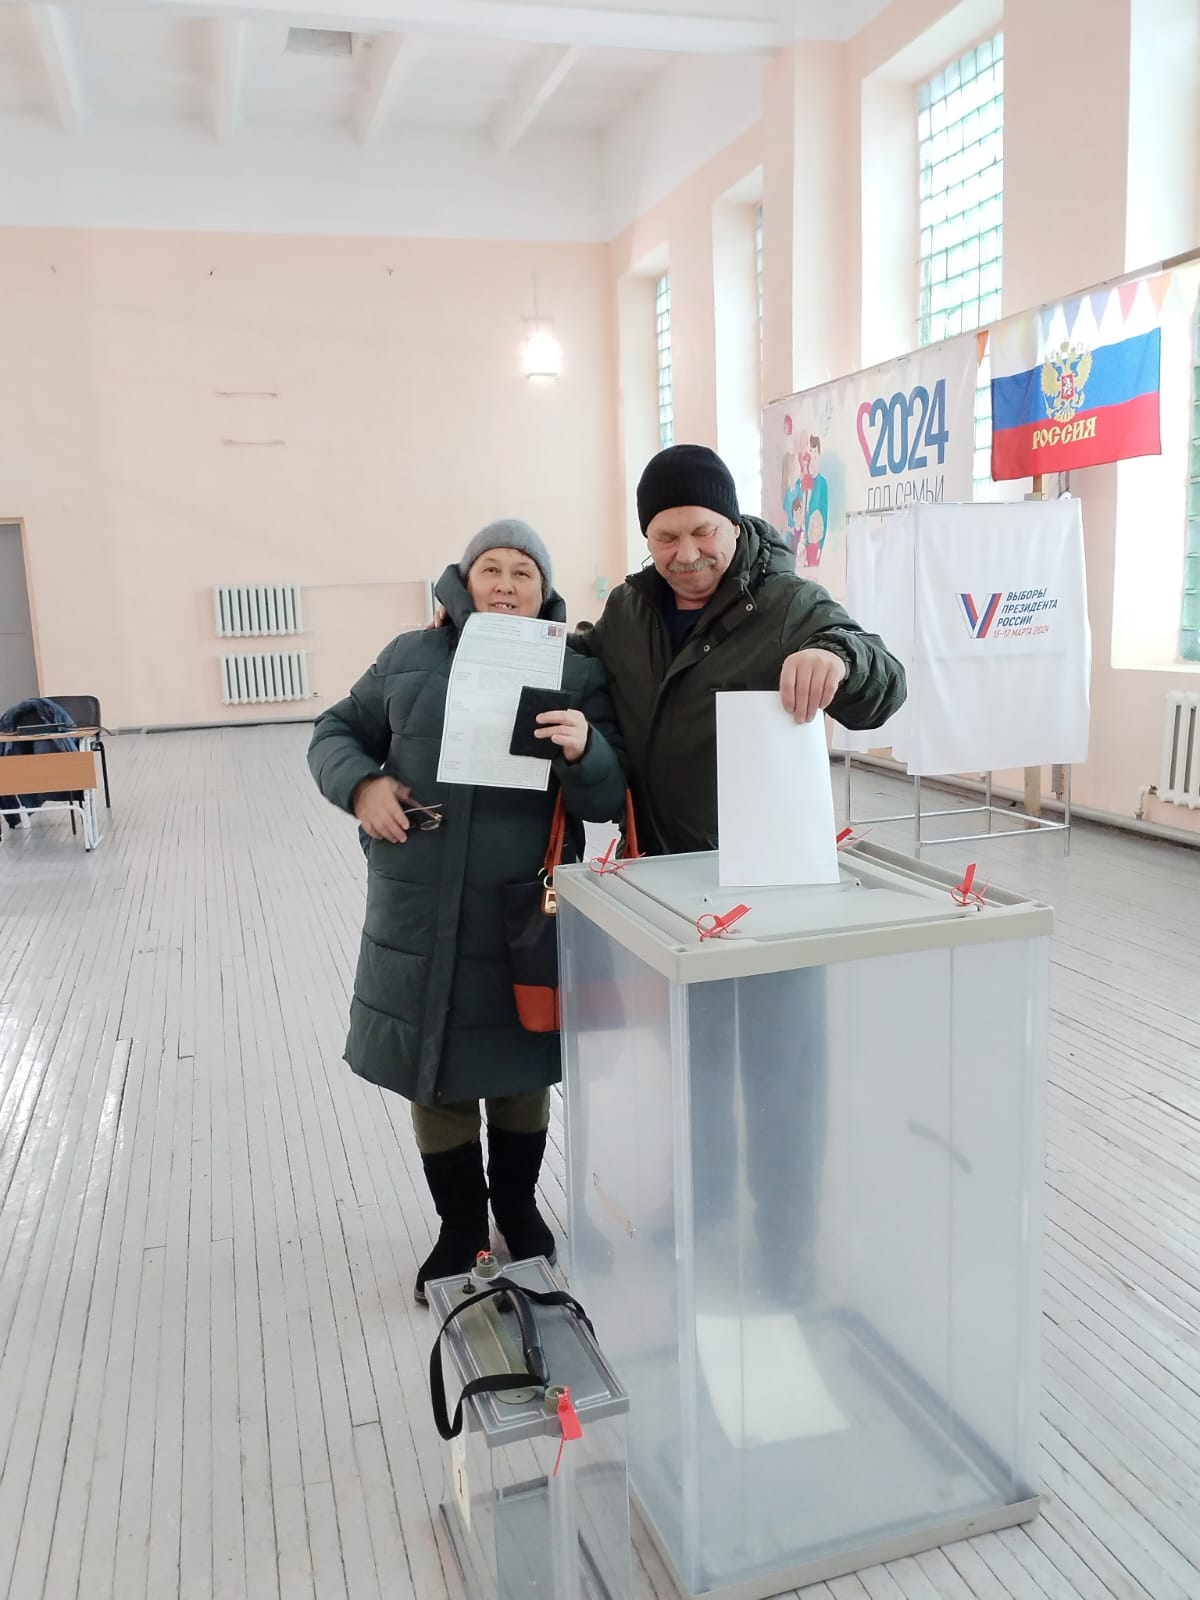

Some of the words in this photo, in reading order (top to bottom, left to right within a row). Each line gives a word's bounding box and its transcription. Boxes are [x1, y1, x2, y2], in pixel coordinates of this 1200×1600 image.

[868, 378, 949, 478] 2024
[1031, 415, 1098, 450] РОССИЯ
[1006, 588, 1047, 602] ВЫБОРЫ
[1001, 599, 1058, 614] ПРЕЗИДЕНТА
[997, 615, 1033, 627] РОССИИ
[1011, 627, 1032, 638] МАРТА
